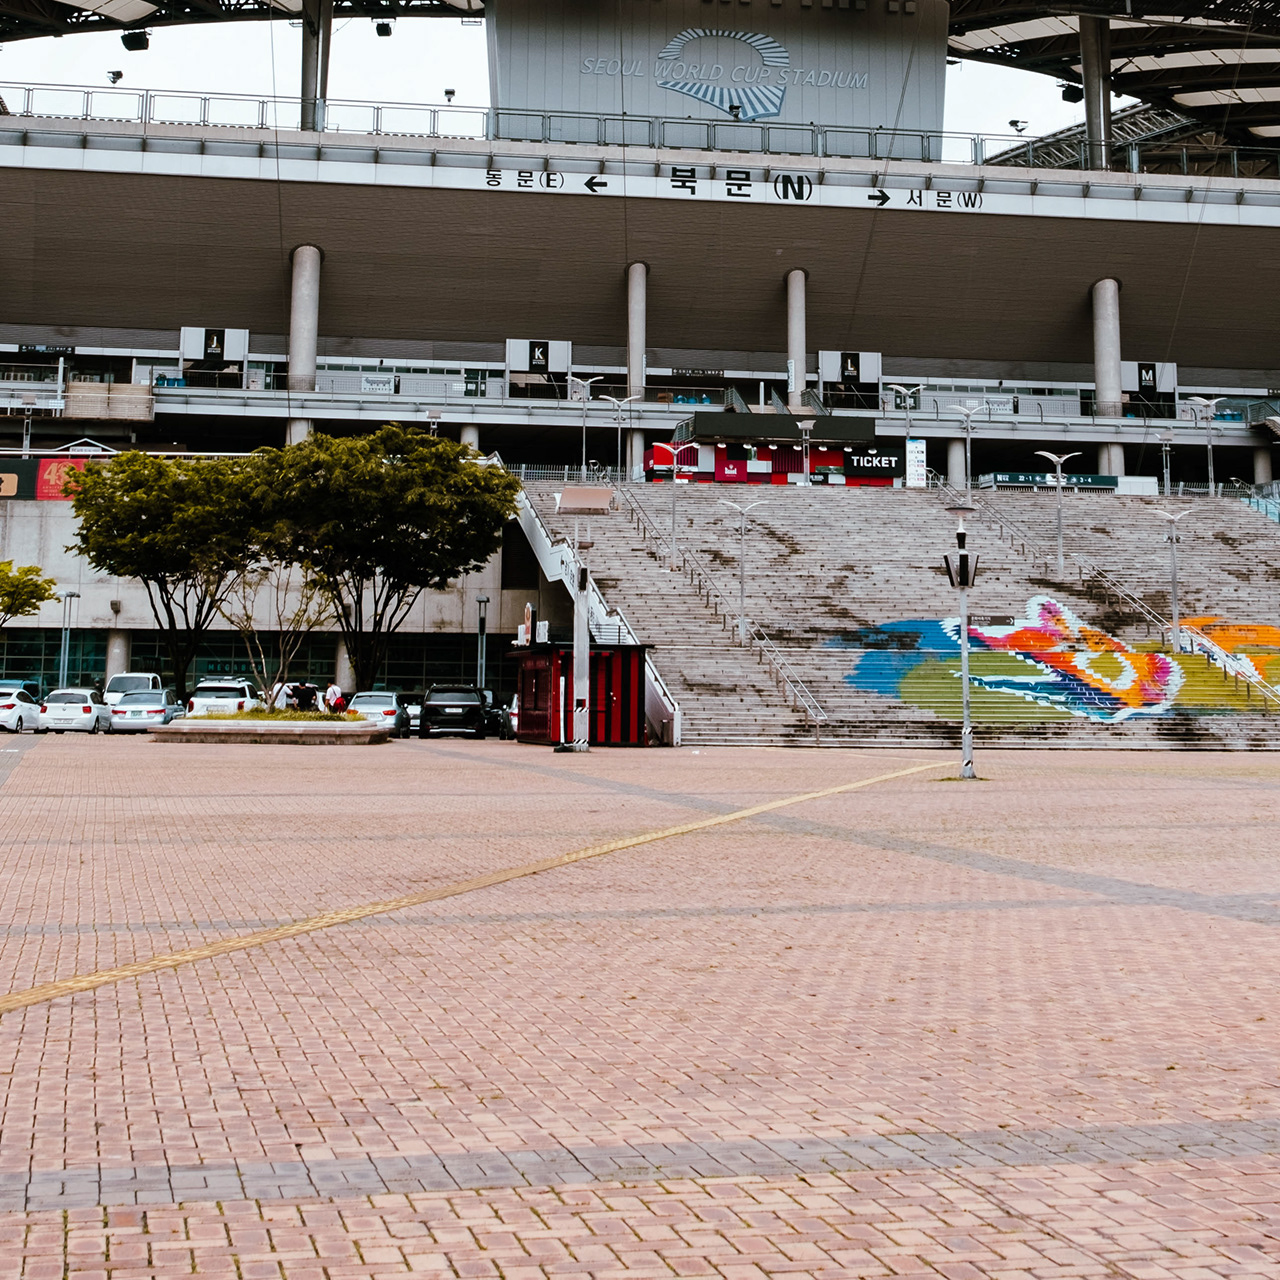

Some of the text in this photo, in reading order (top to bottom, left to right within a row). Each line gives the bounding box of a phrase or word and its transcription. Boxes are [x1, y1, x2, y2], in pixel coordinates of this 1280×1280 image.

[579, 57, 869, 89] SEOUL WORLD CUP STADIUM
[211, 335, 218, 348] J
[534, 347, 544, 360] K
[847, 358, 854, 371] L
[1141, 369, 1153, 381] M
[851, 456, 898, 468] TICKET
